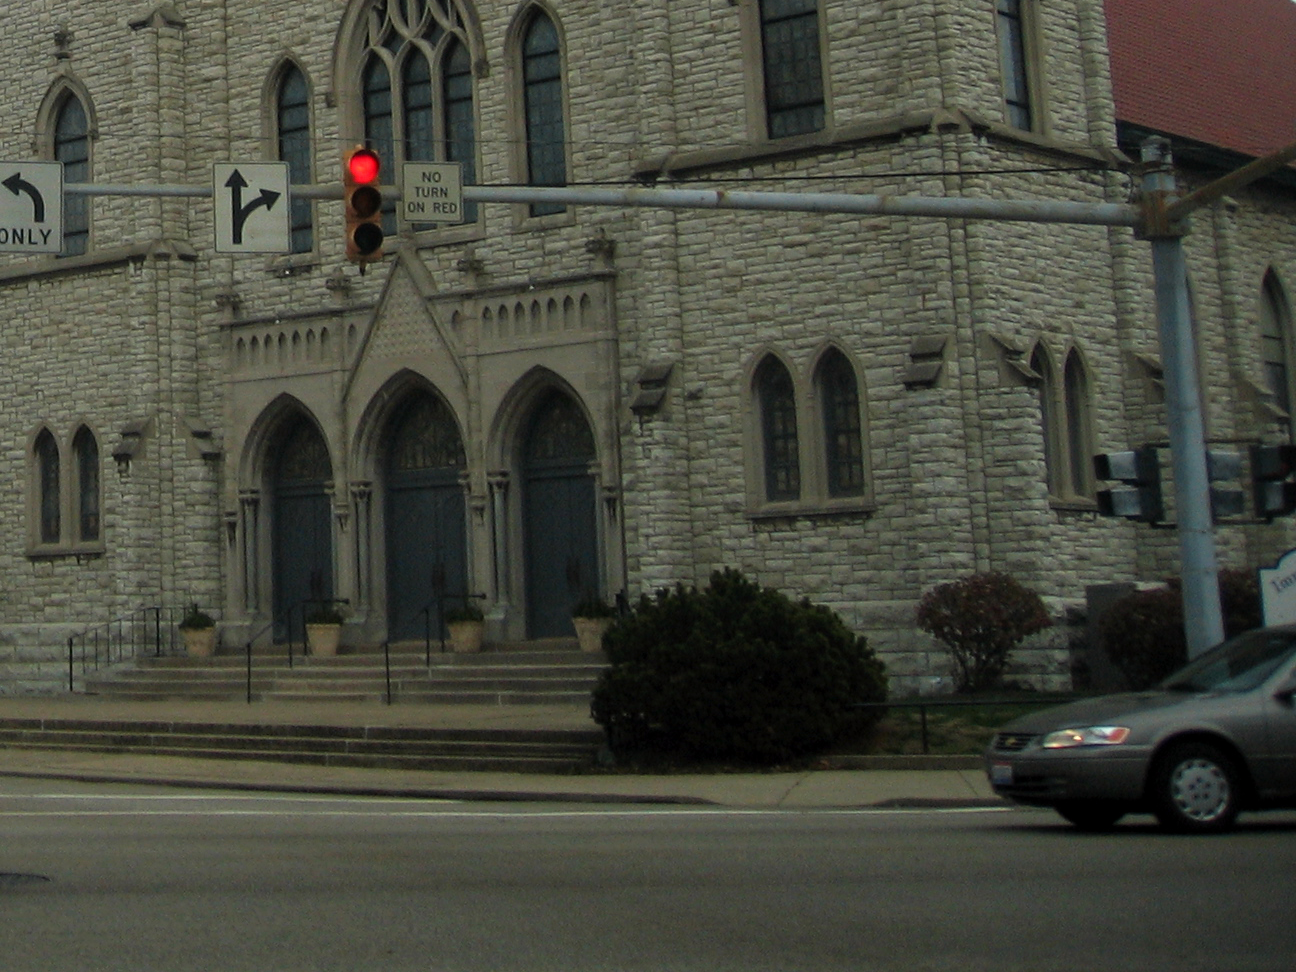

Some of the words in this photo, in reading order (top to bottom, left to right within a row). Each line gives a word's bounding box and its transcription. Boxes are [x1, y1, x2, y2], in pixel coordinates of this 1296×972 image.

[421, 171, 442, 183] NO
[415, 186, 448, 198] TURN
[407, 201, 425, 213] ON
[433, 202, 457, 214] RED
